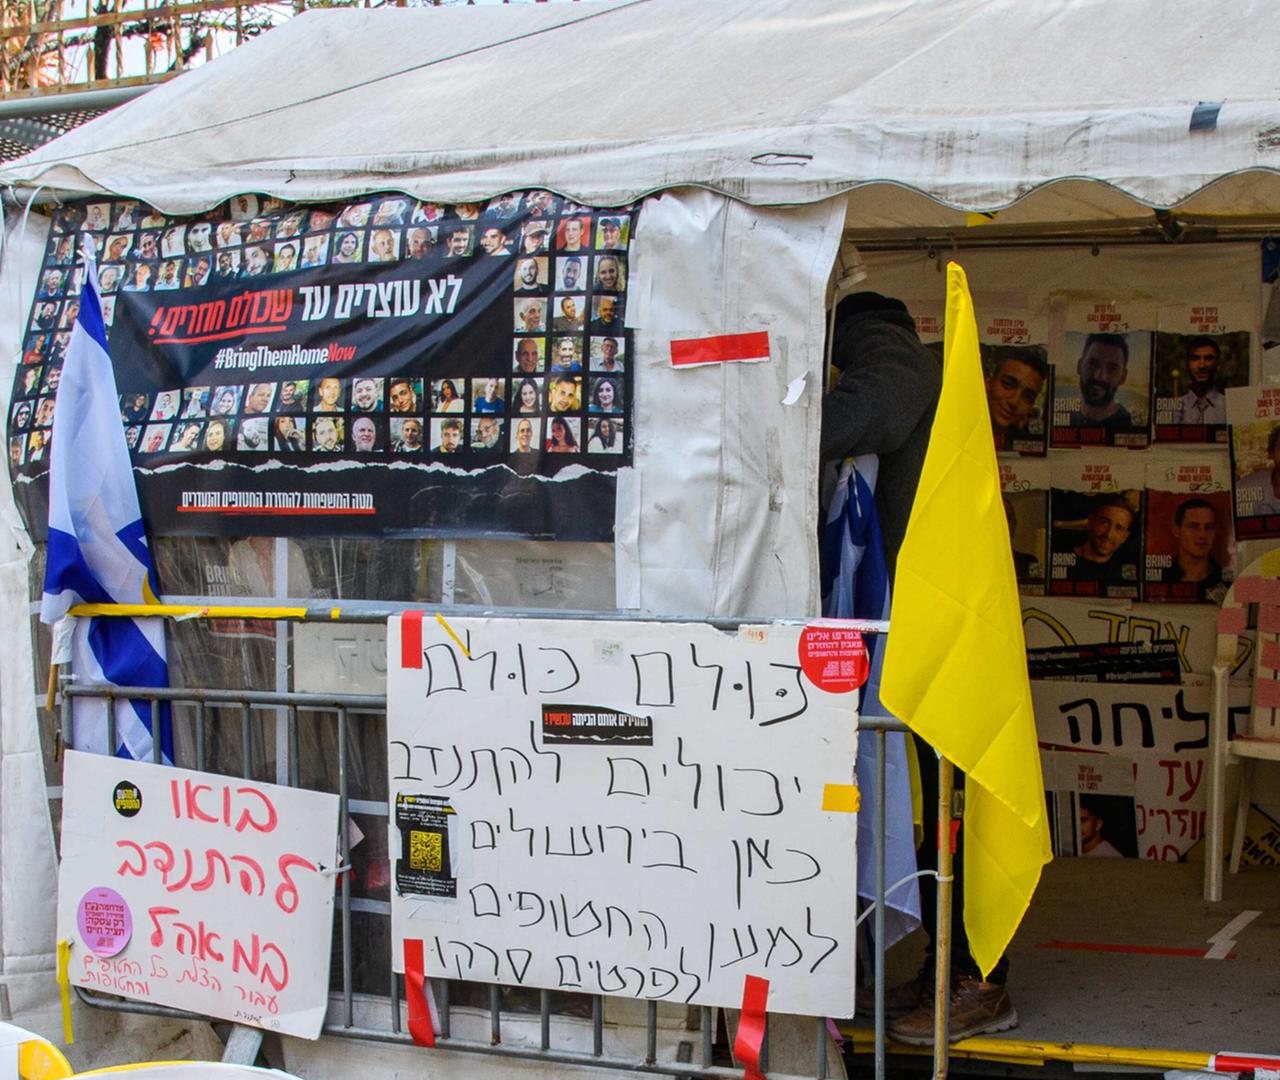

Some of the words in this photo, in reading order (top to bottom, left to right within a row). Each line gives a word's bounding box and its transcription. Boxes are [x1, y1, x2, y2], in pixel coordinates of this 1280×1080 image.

[225, 284, 294, 329] שכולם
[298, 283, 330, 322] עד
[334, 278, 422, 320] עוצרים
[425, 273, 463, 315] לא
[148, 297, 224, 338] חוזרים!
[215, 342, 357, 370] #BringThemHomeNow
[1054, 399, 1081, 412] BRING
[1054, 413, 1071, 427] HIM
[182, 490, 220, 507] והנעדרים
[222, 490, 263, 508] החטופים
[265, 491, 301, 508] להחזרת
[303, 492, 350, 509] המשפחות
[352, 493, 373, 509] מטה
[1052, 552, 1076, 567] BRING
[1053, 567, 1068, 580] HIM
[390, 720, 562, 796] להתנדב
[606, 738, 803, 817] יכולים
[1159, 760, 1203, 802] עד
[170, 778, 278, 835] בואו
[470, 808, 699, 874] בירושלים
[116, 839, 319, 916] להתנדב
[731, 837, 822, 910] כאן
[468, 882, 670, 952] החטופים
[83, 954, 143, 977] החטופים
[148, 906, 289, 992] במאהל
[429, 936, 534, 985] סרקו
[706, 907, 840, 984] למען
[149, 954, 169, 979] כל
[557, 946, 702, 1004] לפרטים
[233, 985, 280, 1015] עבור
